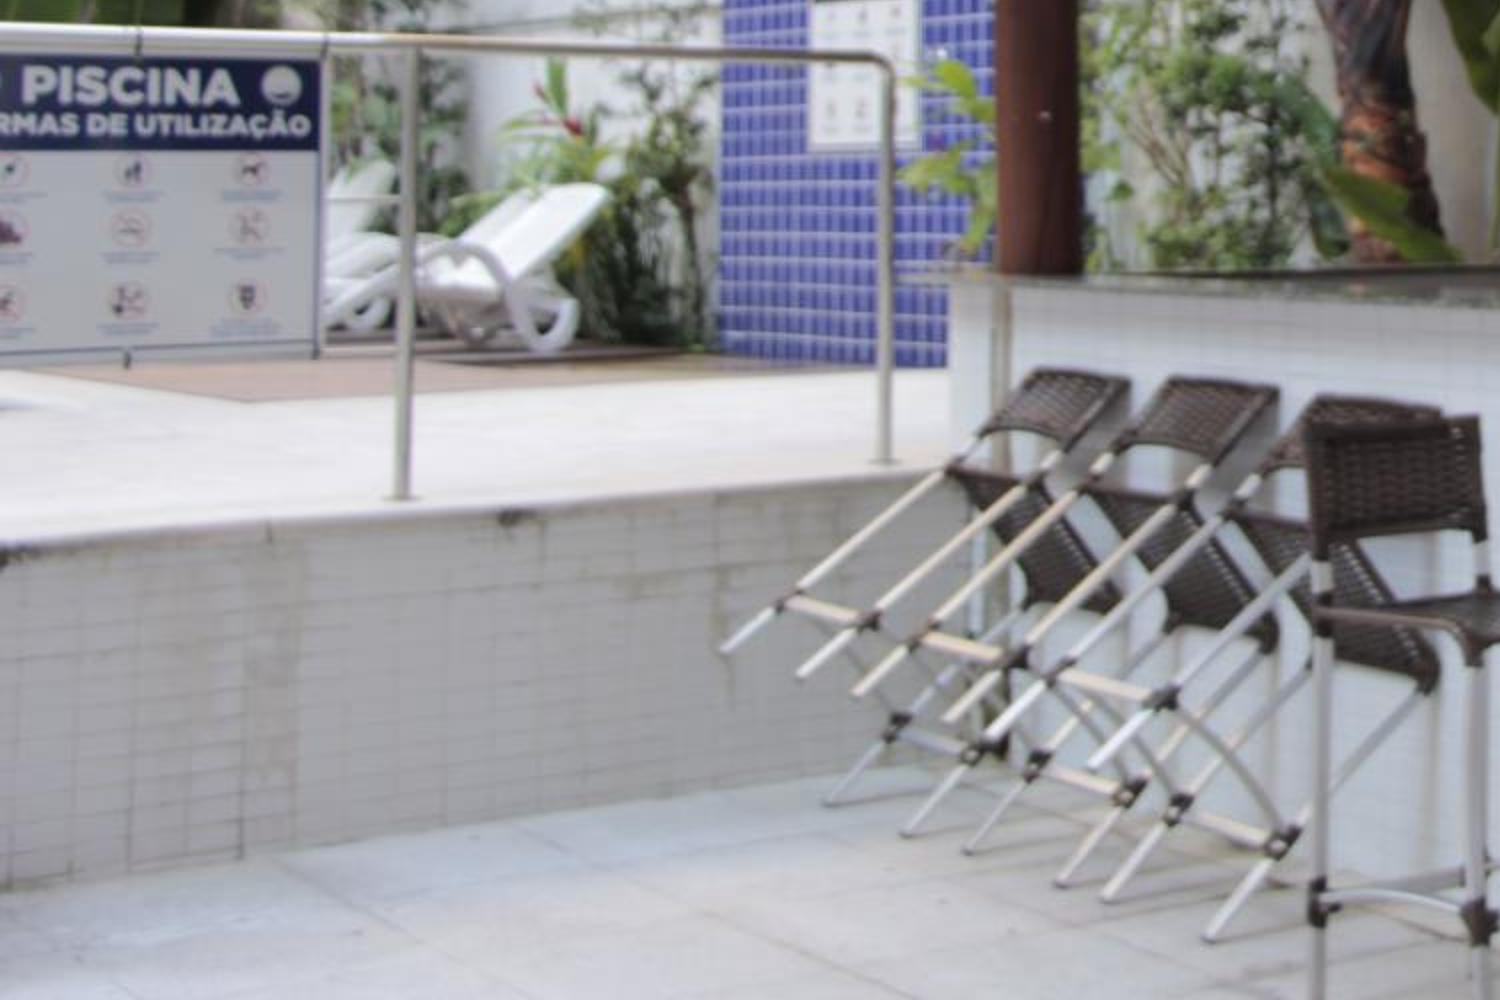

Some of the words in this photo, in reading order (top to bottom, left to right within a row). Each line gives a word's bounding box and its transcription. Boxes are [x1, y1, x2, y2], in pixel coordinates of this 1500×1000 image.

[22, 64, 241, 107] PISCINA
[85, 112, 129, 138] DE
[134, 109, 312, 141] UTILIZAÇÃO
